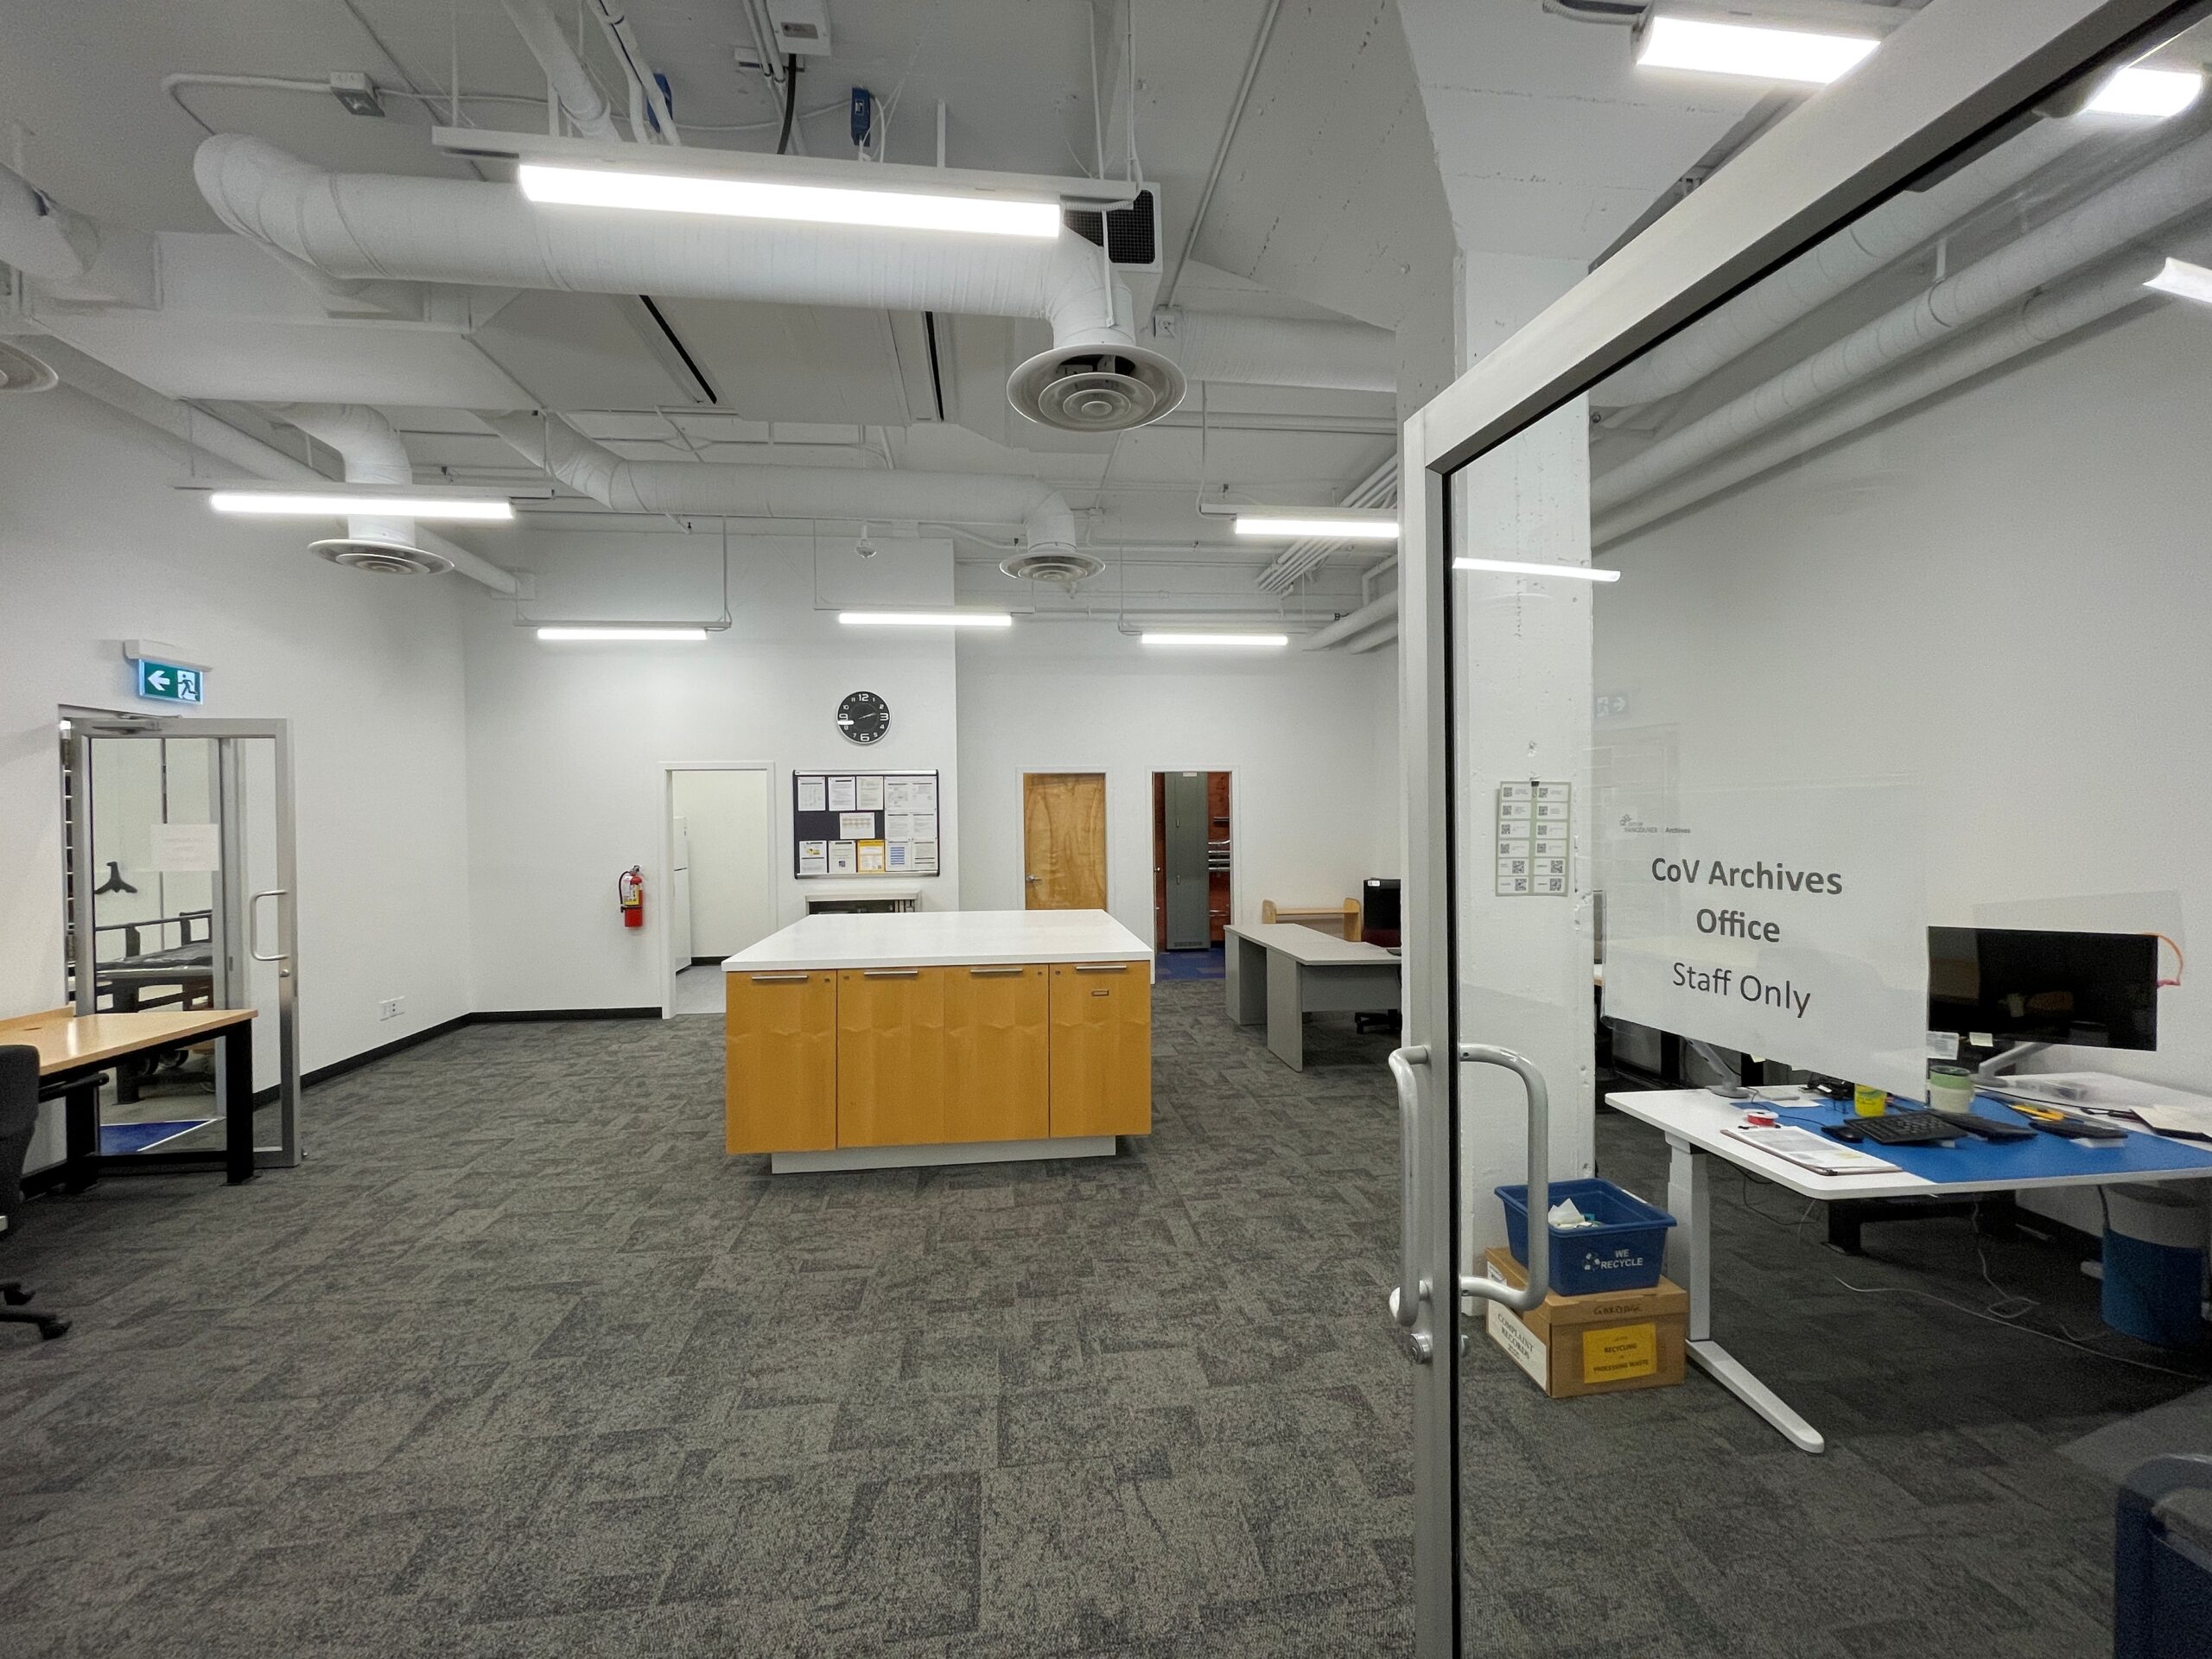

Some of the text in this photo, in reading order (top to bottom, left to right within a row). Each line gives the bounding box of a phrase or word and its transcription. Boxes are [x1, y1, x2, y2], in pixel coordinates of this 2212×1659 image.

[858, 693, 869, 702] 12
[838, 713, 849, 721] 9
[860, 733, 870, 741] 6
[1651, 858, 1843, 895] CoV Archives
[1696, 908, 1780, 943] Office
[1672, 962, 1811, 1018] Staff Only
[1615, 1249, 1630, 1258] WE
[1600, 1257, 1643, 1269] RECYCLE
[1497, 1313, 1534, 1352] COMPLAINT
[1501, 1326, 1530, 1360] RECORDS
[1604, 1342, 1637, 1354] RECYCLING
